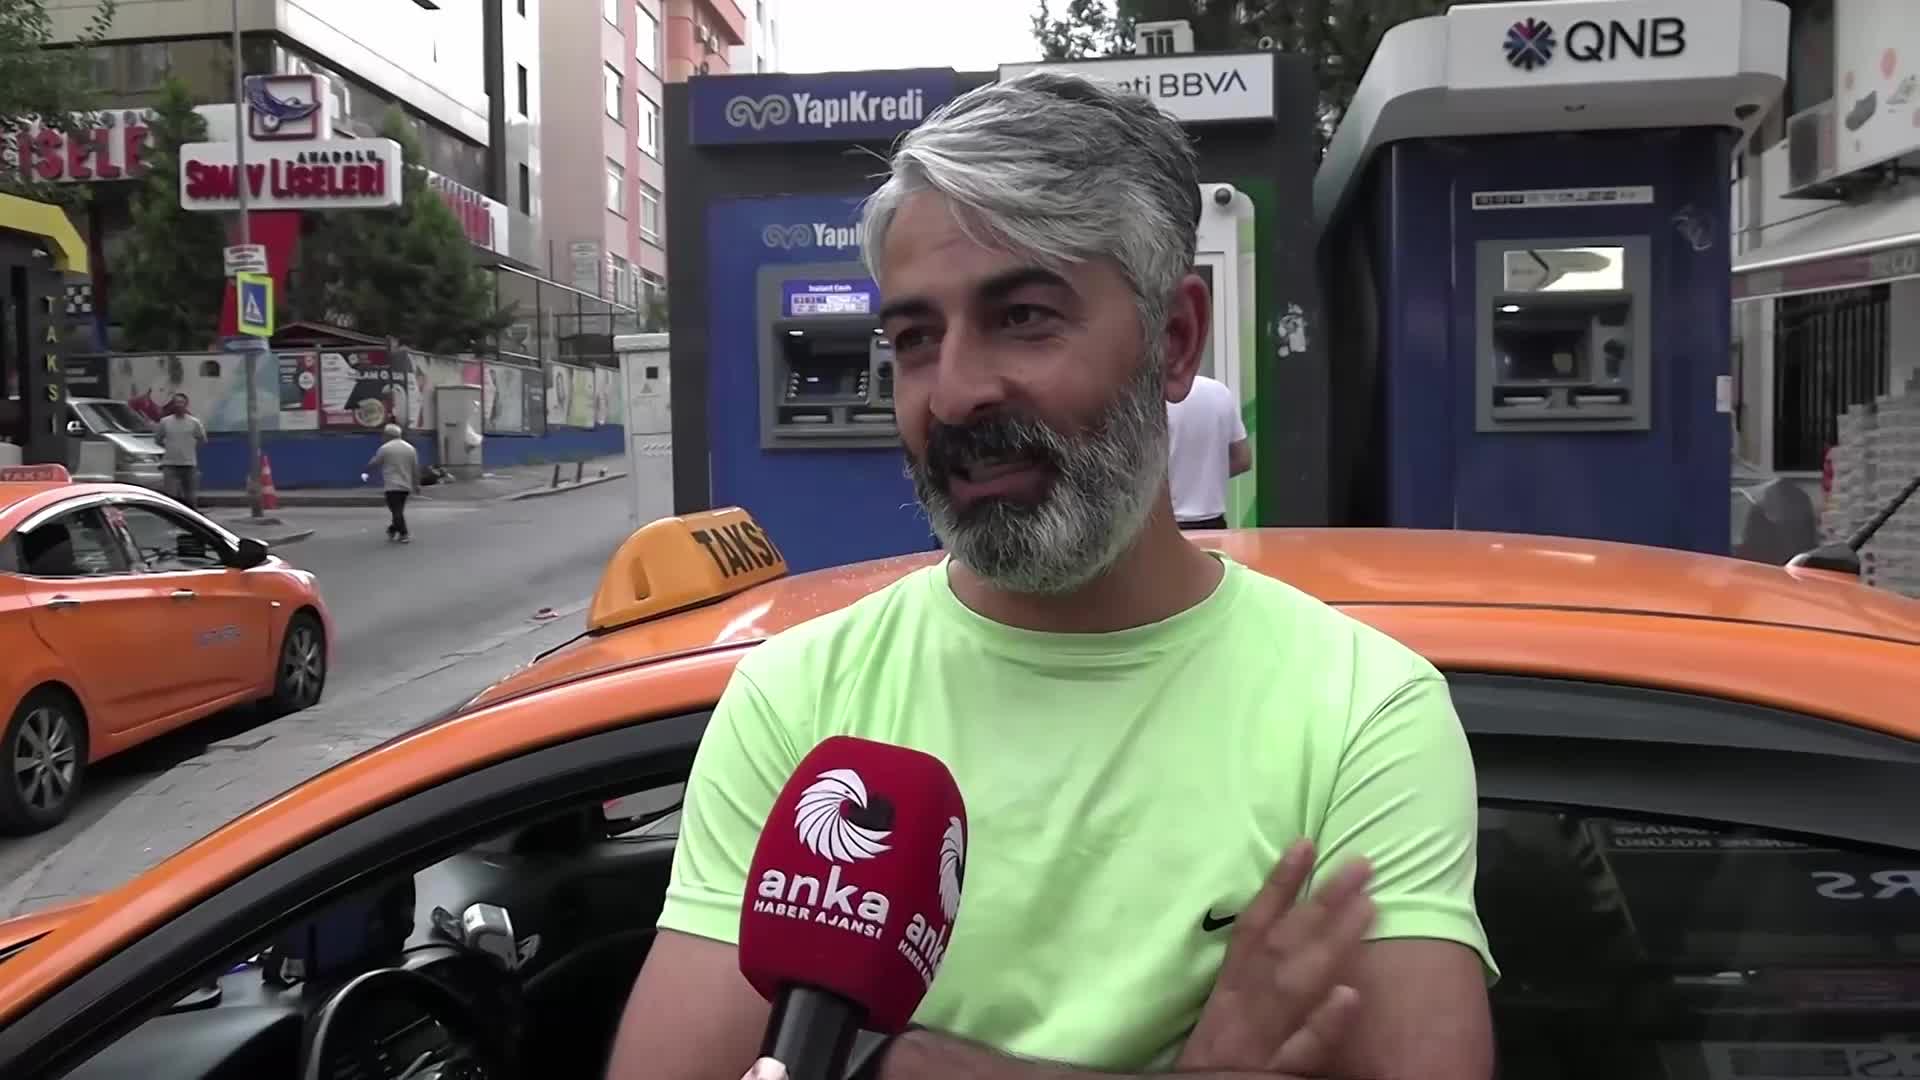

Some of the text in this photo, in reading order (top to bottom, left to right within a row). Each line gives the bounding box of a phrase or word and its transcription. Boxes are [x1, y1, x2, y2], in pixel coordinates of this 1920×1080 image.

[1565, 17, 1685, 62] QNB
[1159, 69, 1247, 98] BBVA
[792, 89, 923, 128] YapıKredi
[757, 865, 890, 924] anka
[753, 900, 883, 939] HABER AJANSI
